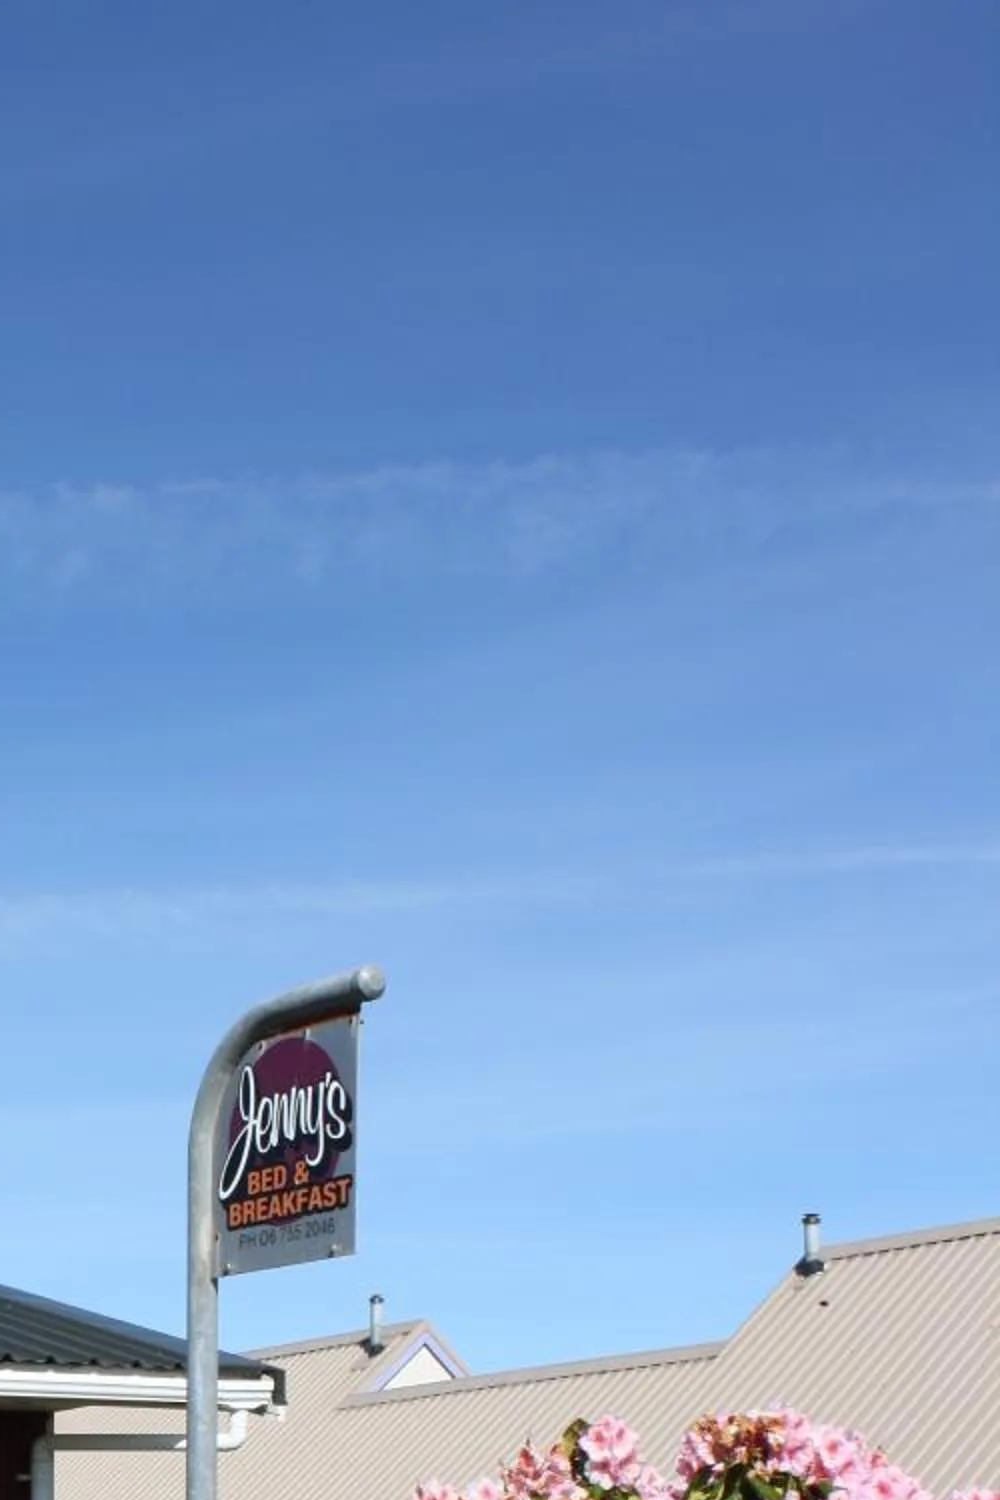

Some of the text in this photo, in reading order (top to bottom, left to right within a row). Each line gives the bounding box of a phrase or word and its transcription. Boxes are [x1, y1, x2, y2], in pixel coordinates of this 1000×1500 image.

[219, 1065, 346, 1200] Jenny's
[228, 1177, 352, 1227] BREAKFAST
[247, 1160, 310, 1195] BED &
